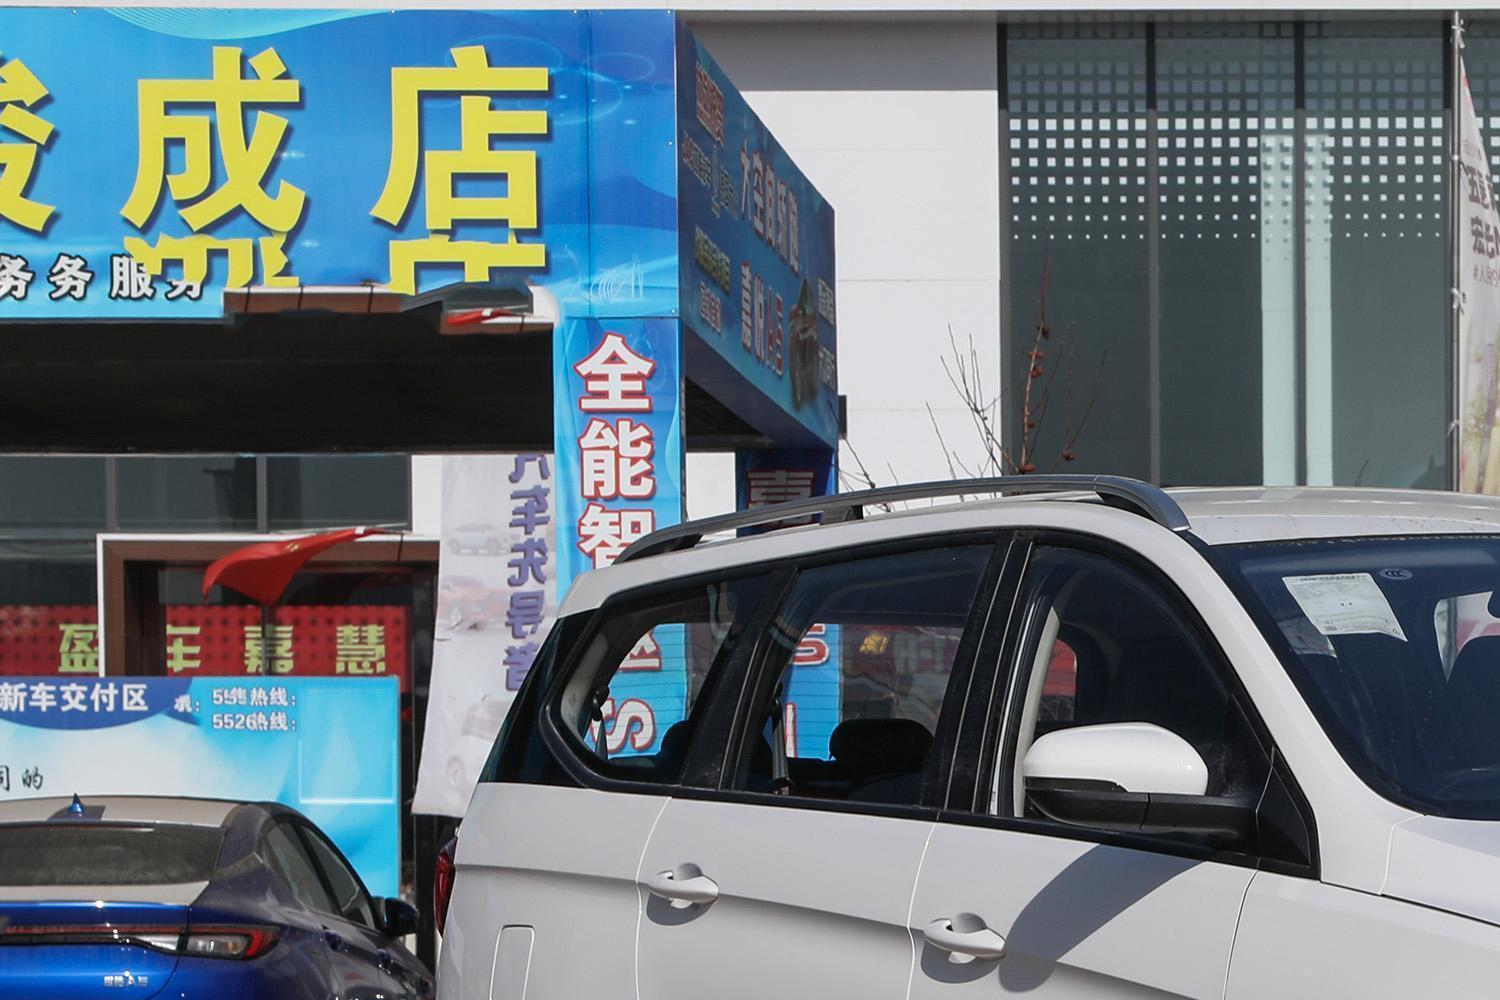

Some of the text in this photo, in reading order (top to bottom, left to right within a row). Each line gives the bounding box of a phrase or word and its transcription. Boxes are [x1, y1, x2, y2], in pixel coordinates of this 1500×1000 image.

[0, 683, 149, 713] 新车交付区
